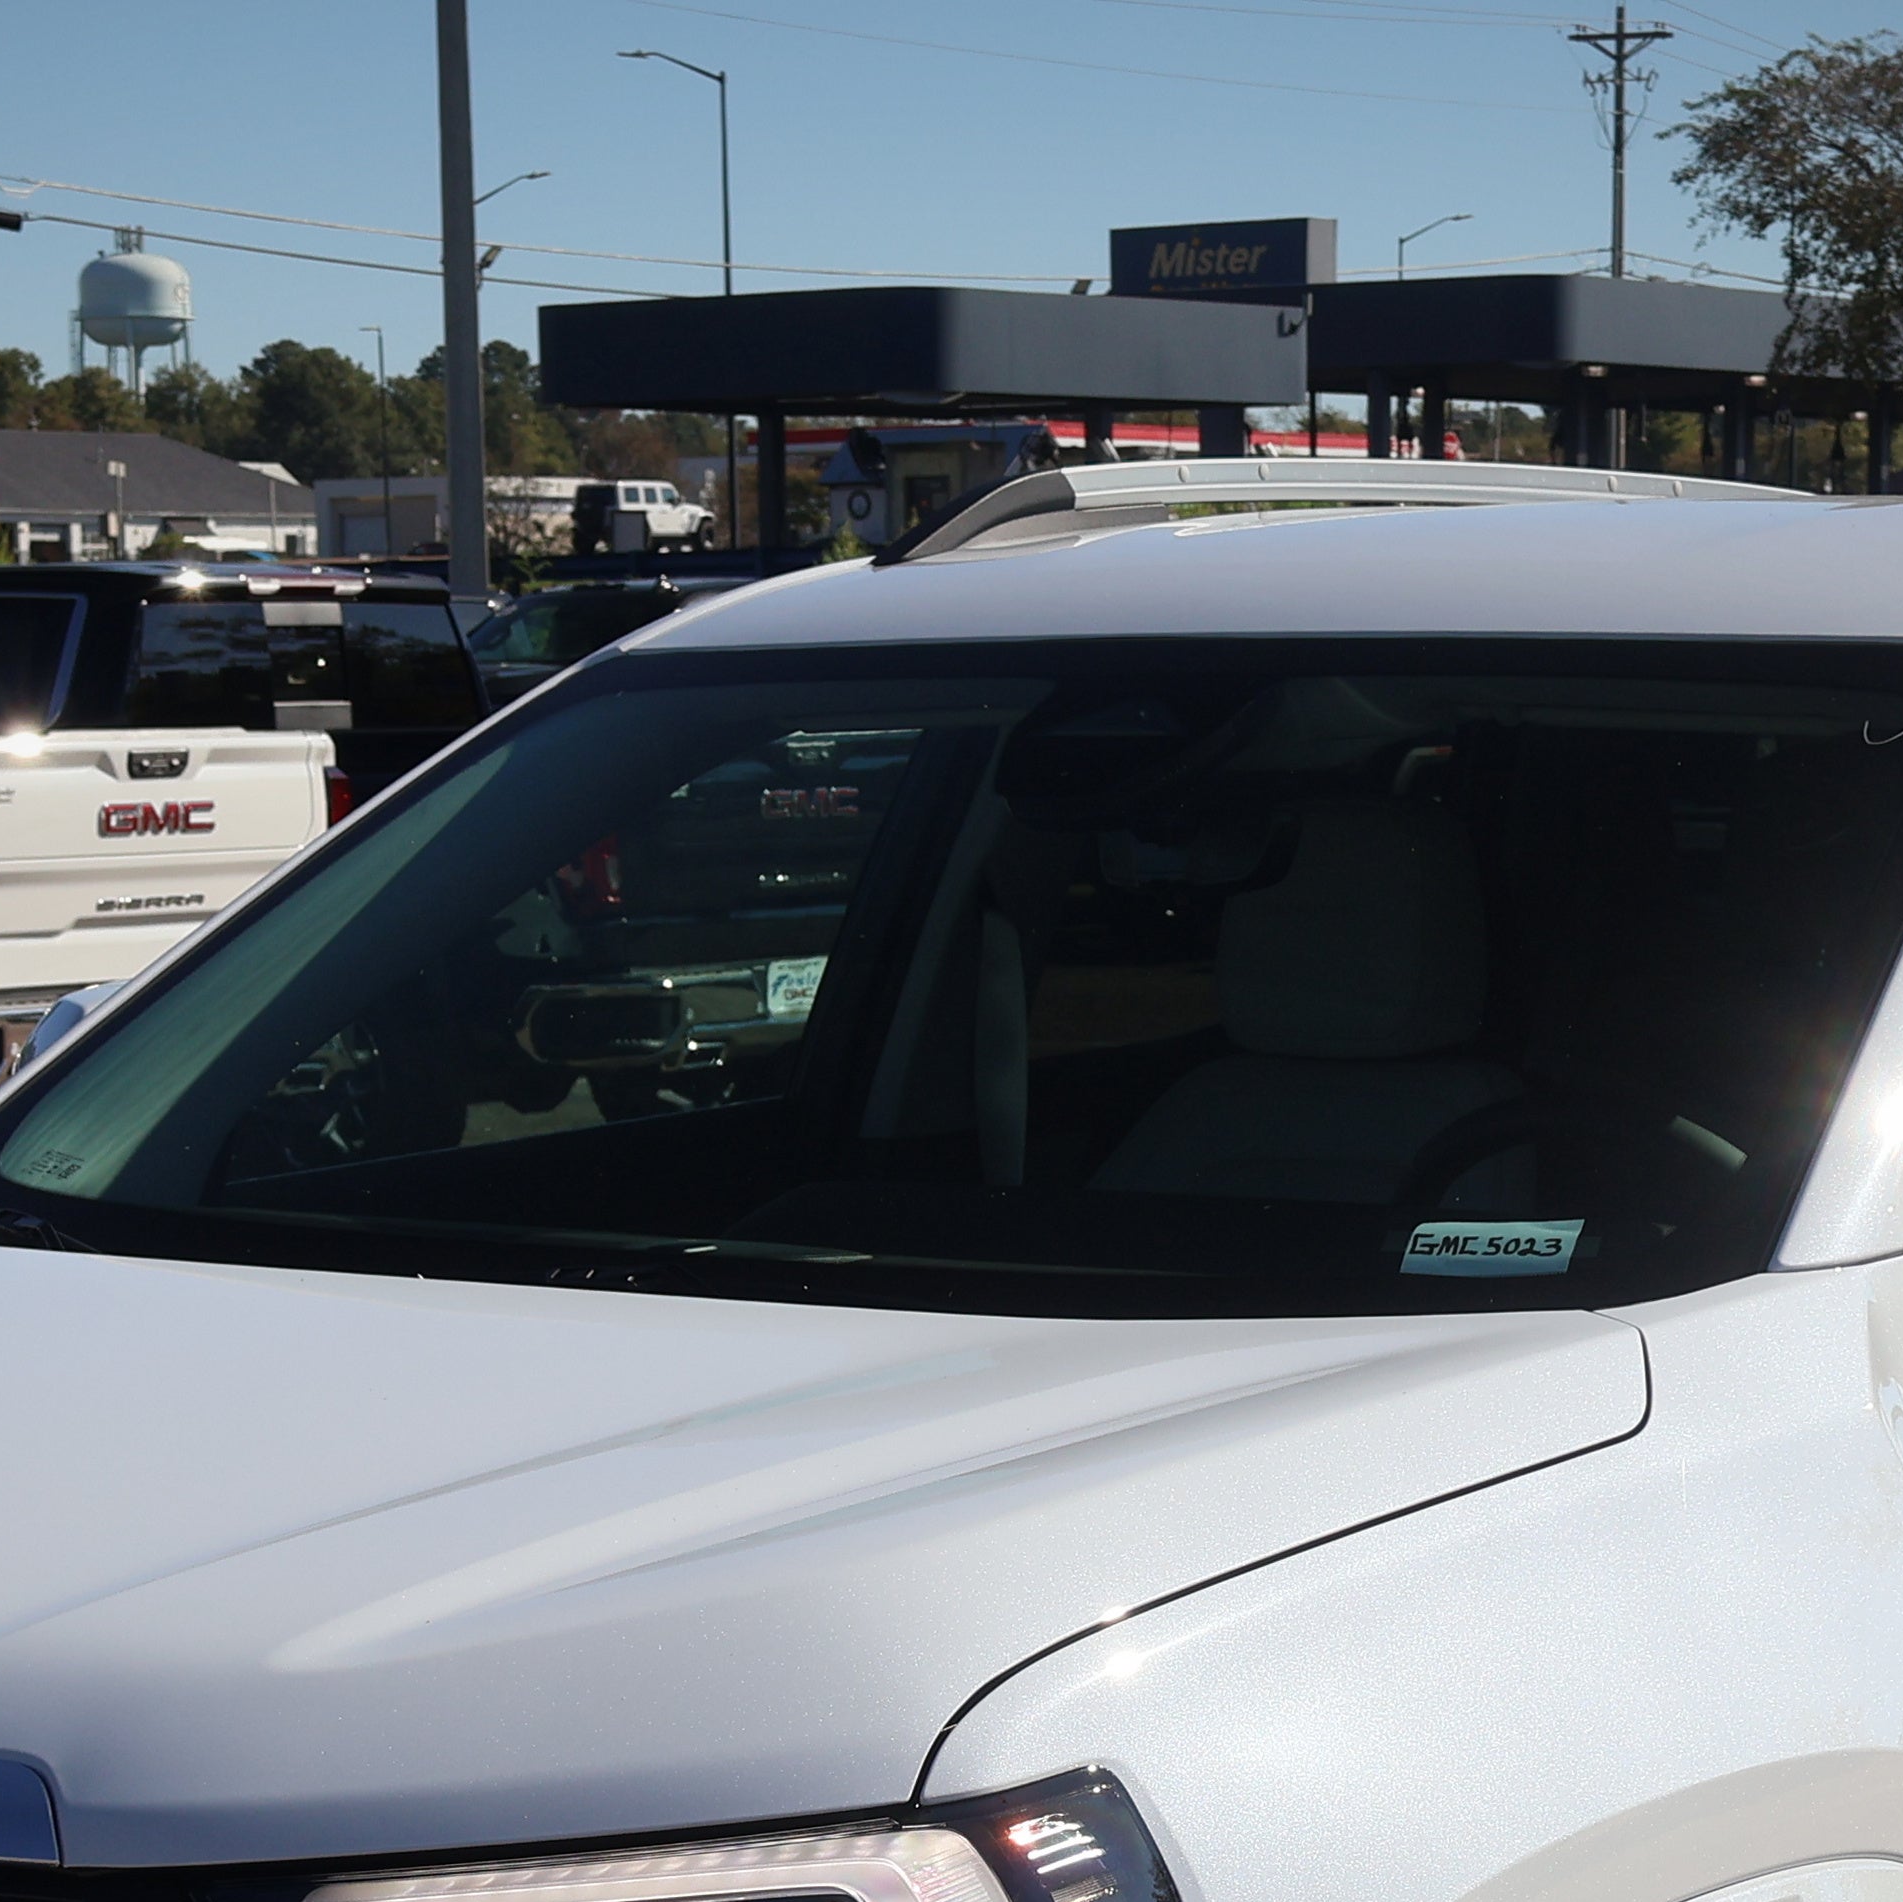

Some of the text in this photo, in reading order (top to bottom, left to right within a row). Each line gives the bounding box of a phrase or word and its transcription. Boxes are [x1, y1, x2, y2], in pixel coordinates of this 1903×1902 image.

[1149, 237, 1268, 278] Mister
[98, 800, 215, 837] GMC
[761, 787, 859, 819] GMC
[1409, 1233, 1562, 1256] GMC 5023
